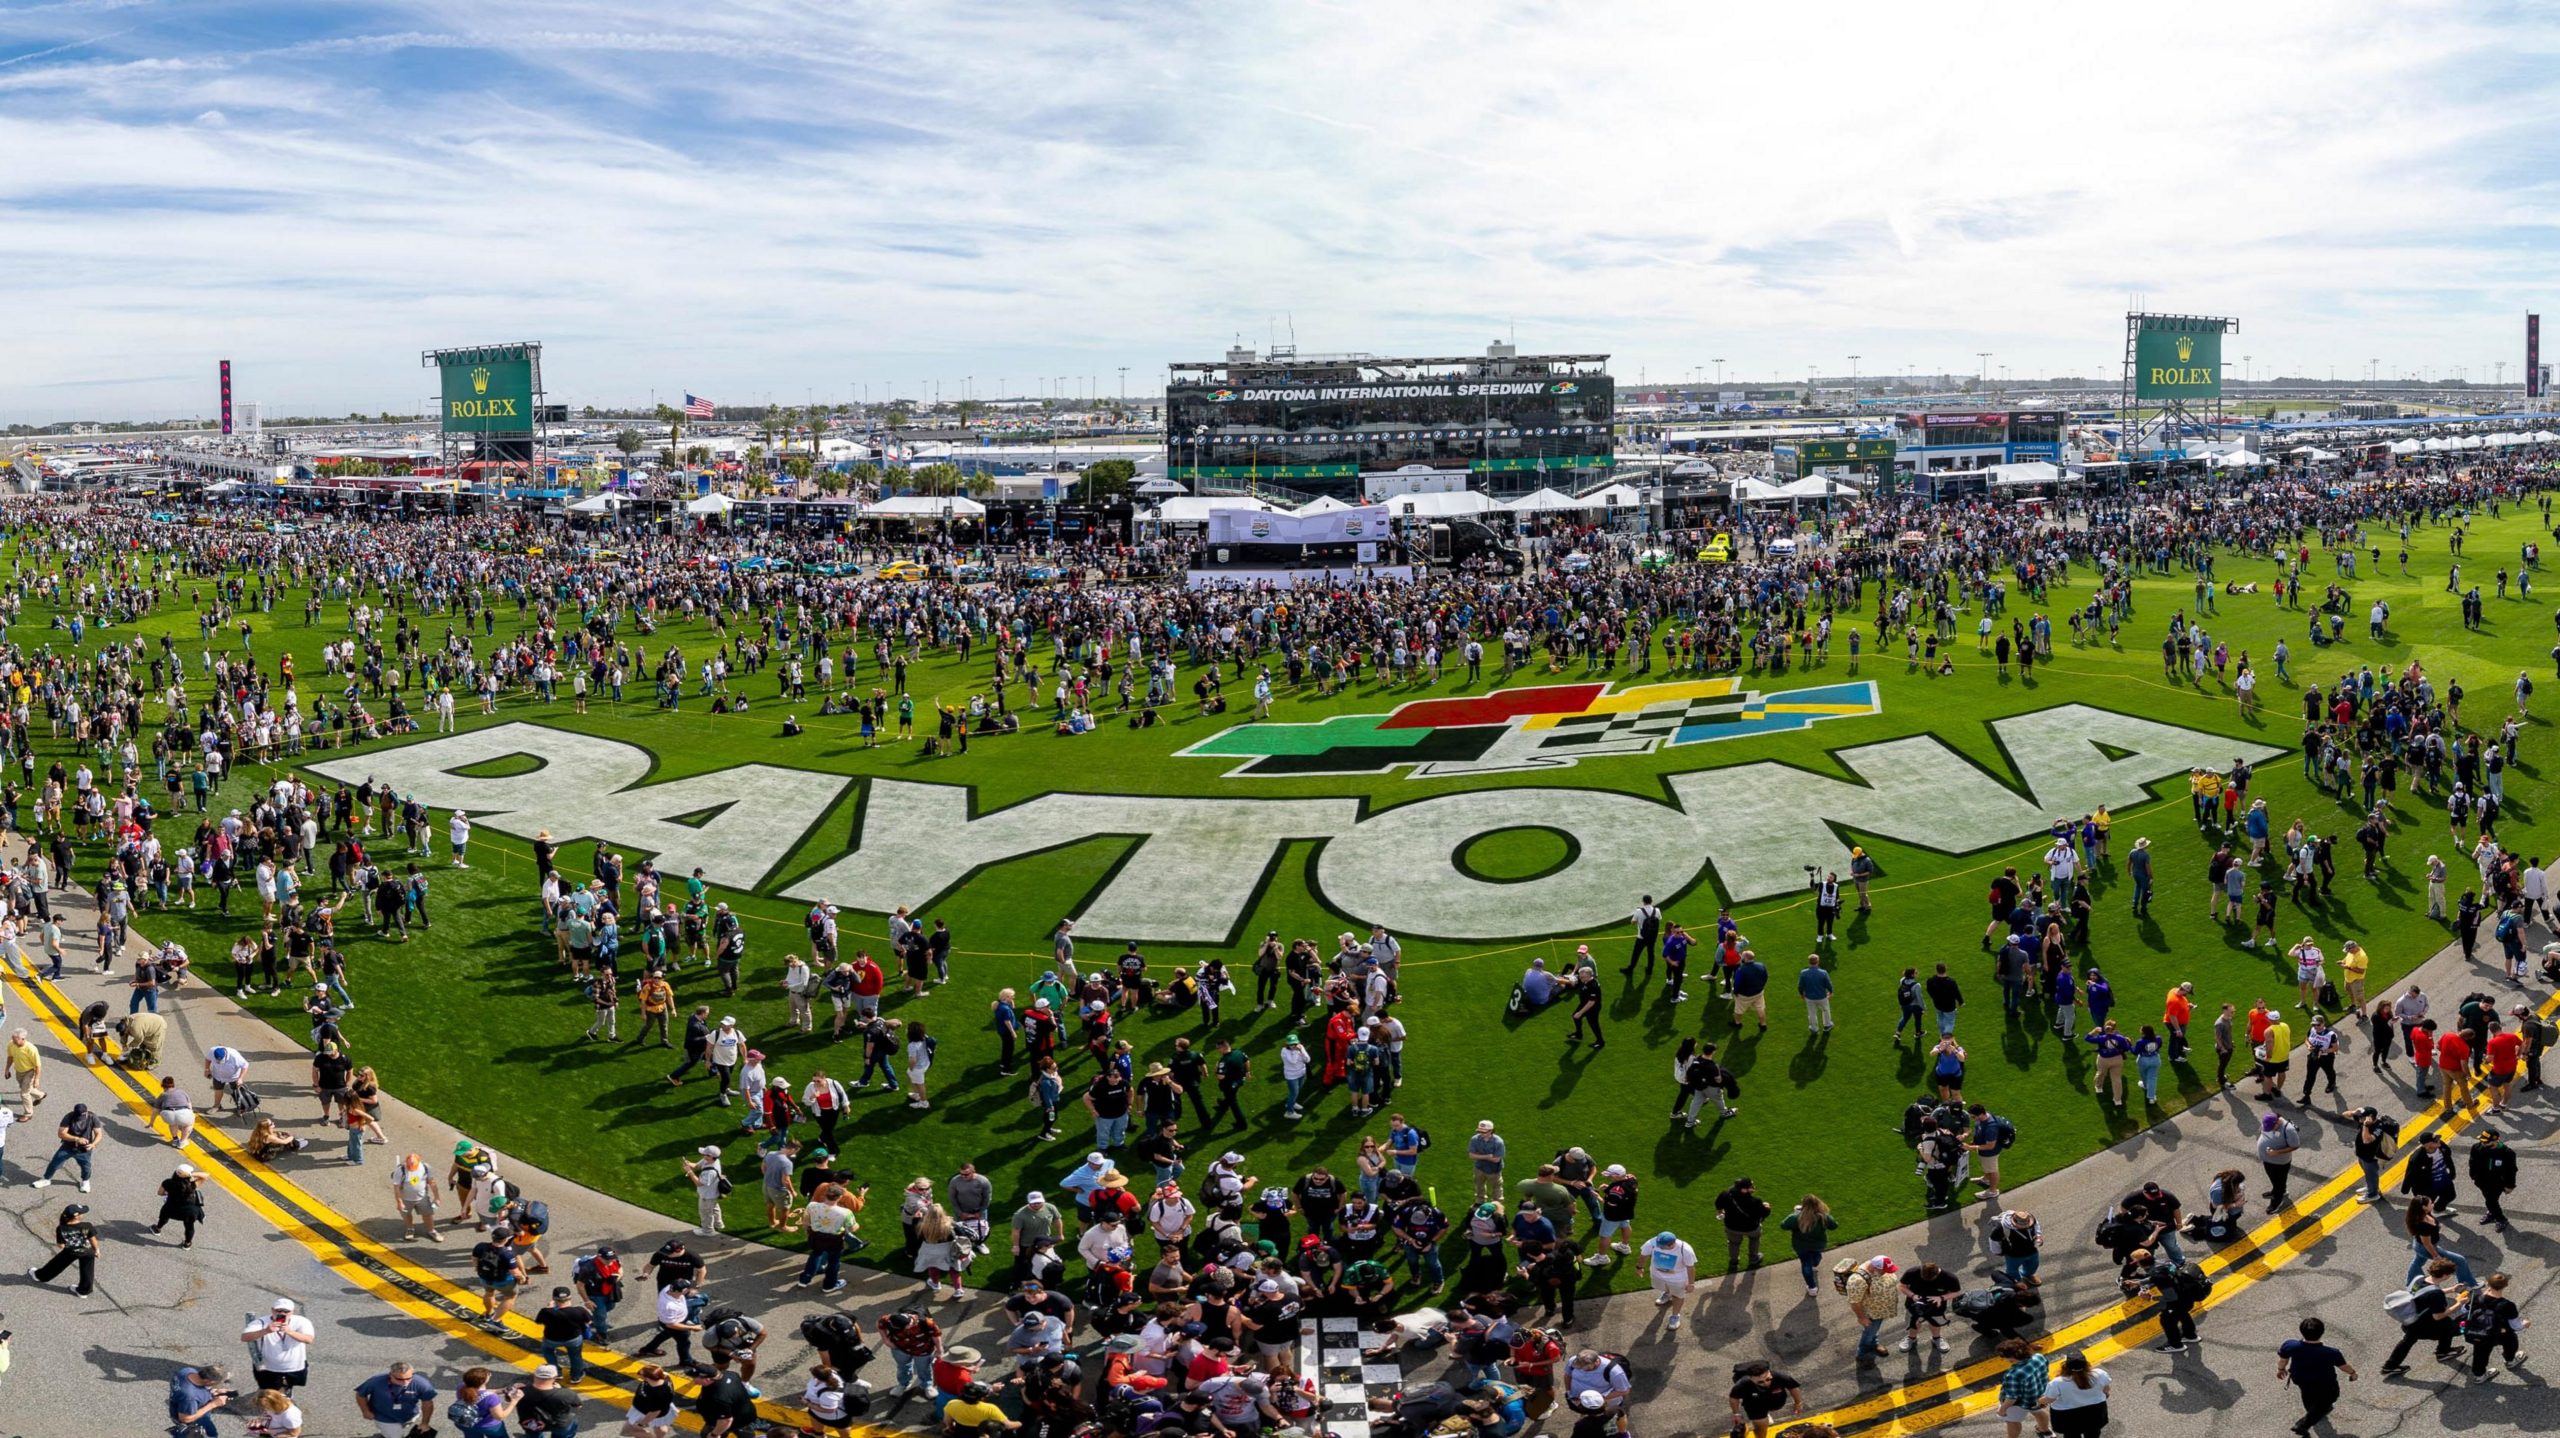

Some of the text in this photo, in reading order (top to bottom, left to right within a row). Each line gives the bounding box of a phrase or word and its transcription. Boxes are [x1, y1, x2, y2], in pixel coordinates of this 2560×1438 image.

[2151, 368, 2212, 385] ROLEX
[1243, 382, 1545, 401] DAYTONA INTERNATIONAL SPEEDWAY
[451, 399, 517, 418] ROLEX
[306, 704, 2288, 943] DAYTONA
[1510, 989, 1521, 1011] 3
